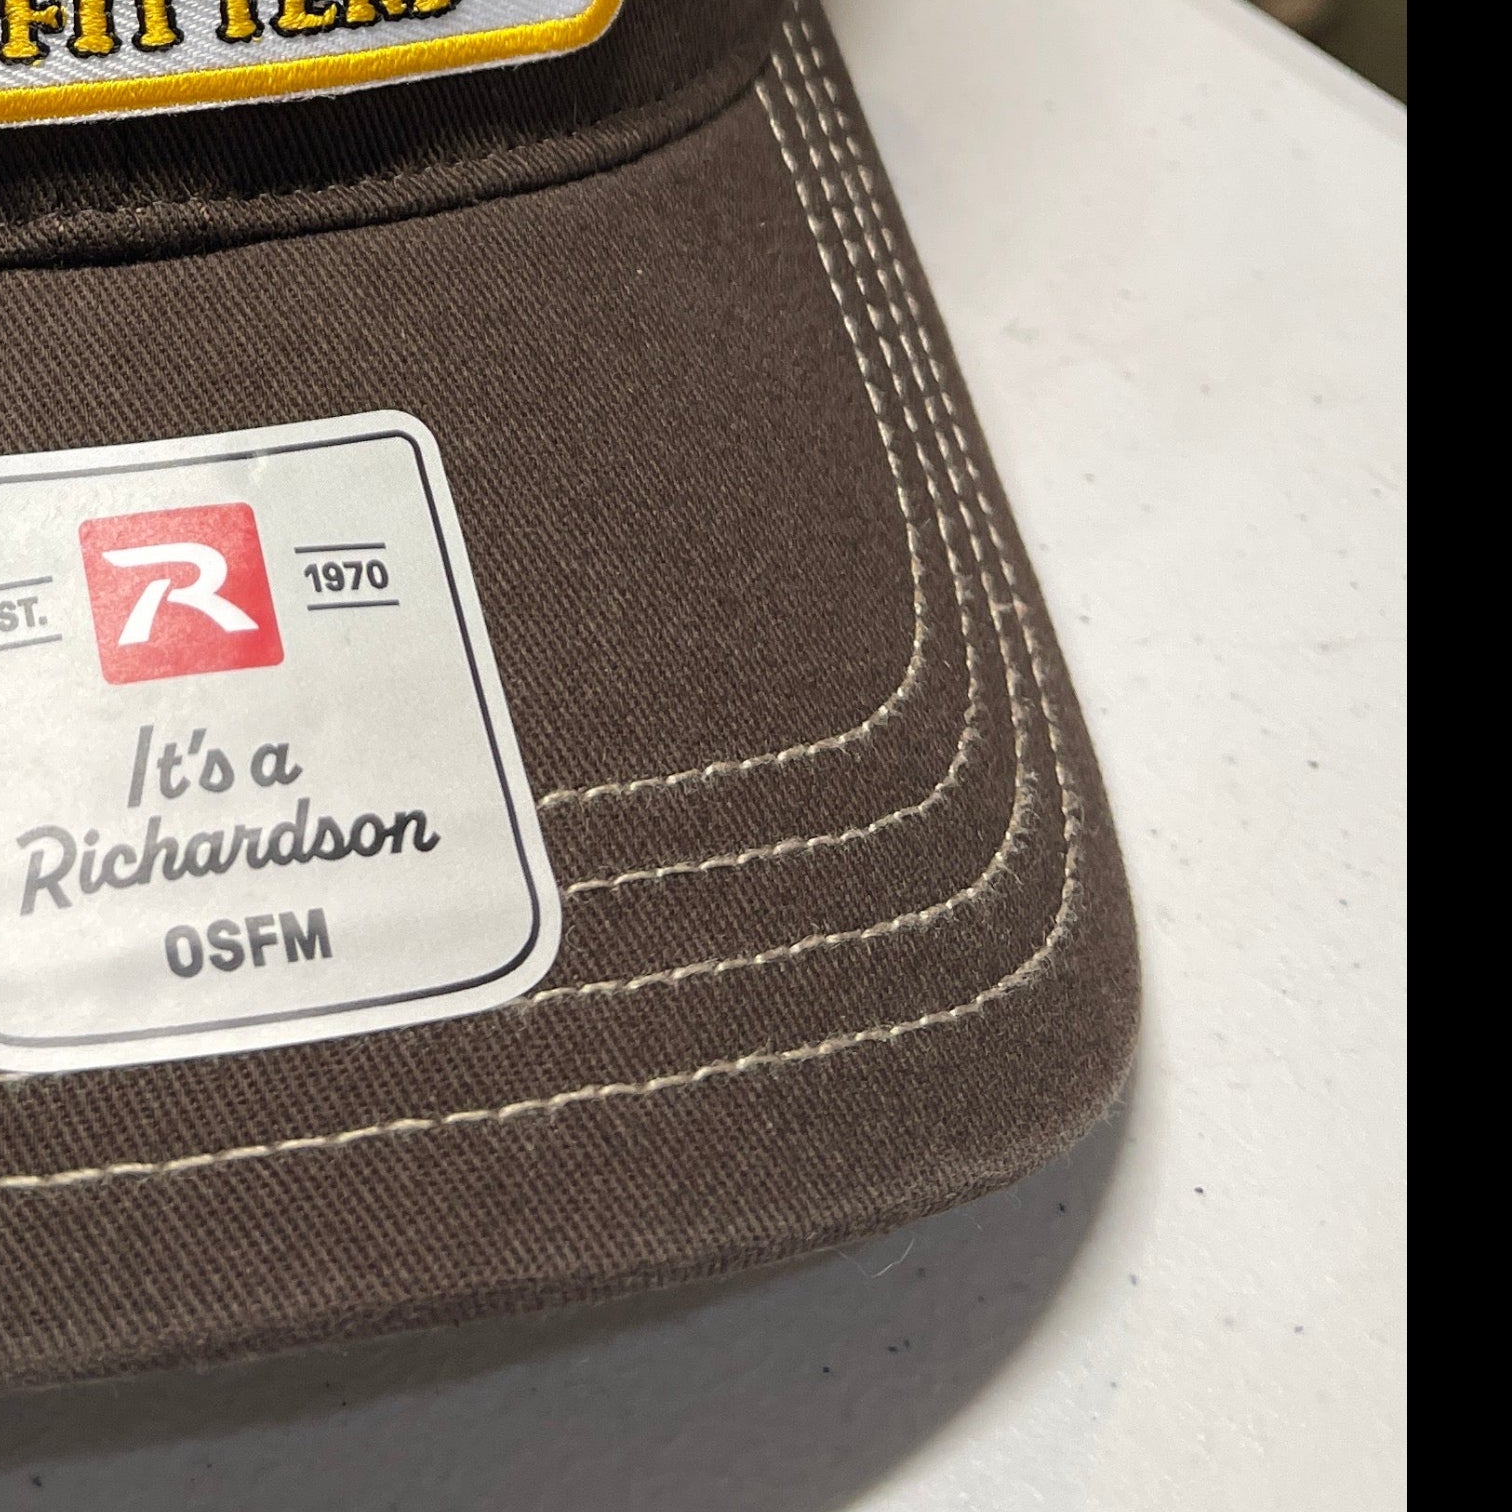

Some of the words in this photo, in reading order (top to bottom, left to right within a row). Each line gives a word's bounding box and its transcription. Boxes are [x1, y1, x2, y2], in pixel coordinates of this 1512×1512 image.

[304, 560, 389, 593] 1970
[127, 725, 235, 808] It's
[252, 742, 303, 787] a
[15, 798, 440, 916] Richardson
[164, 908, 333, 979] OSFM
